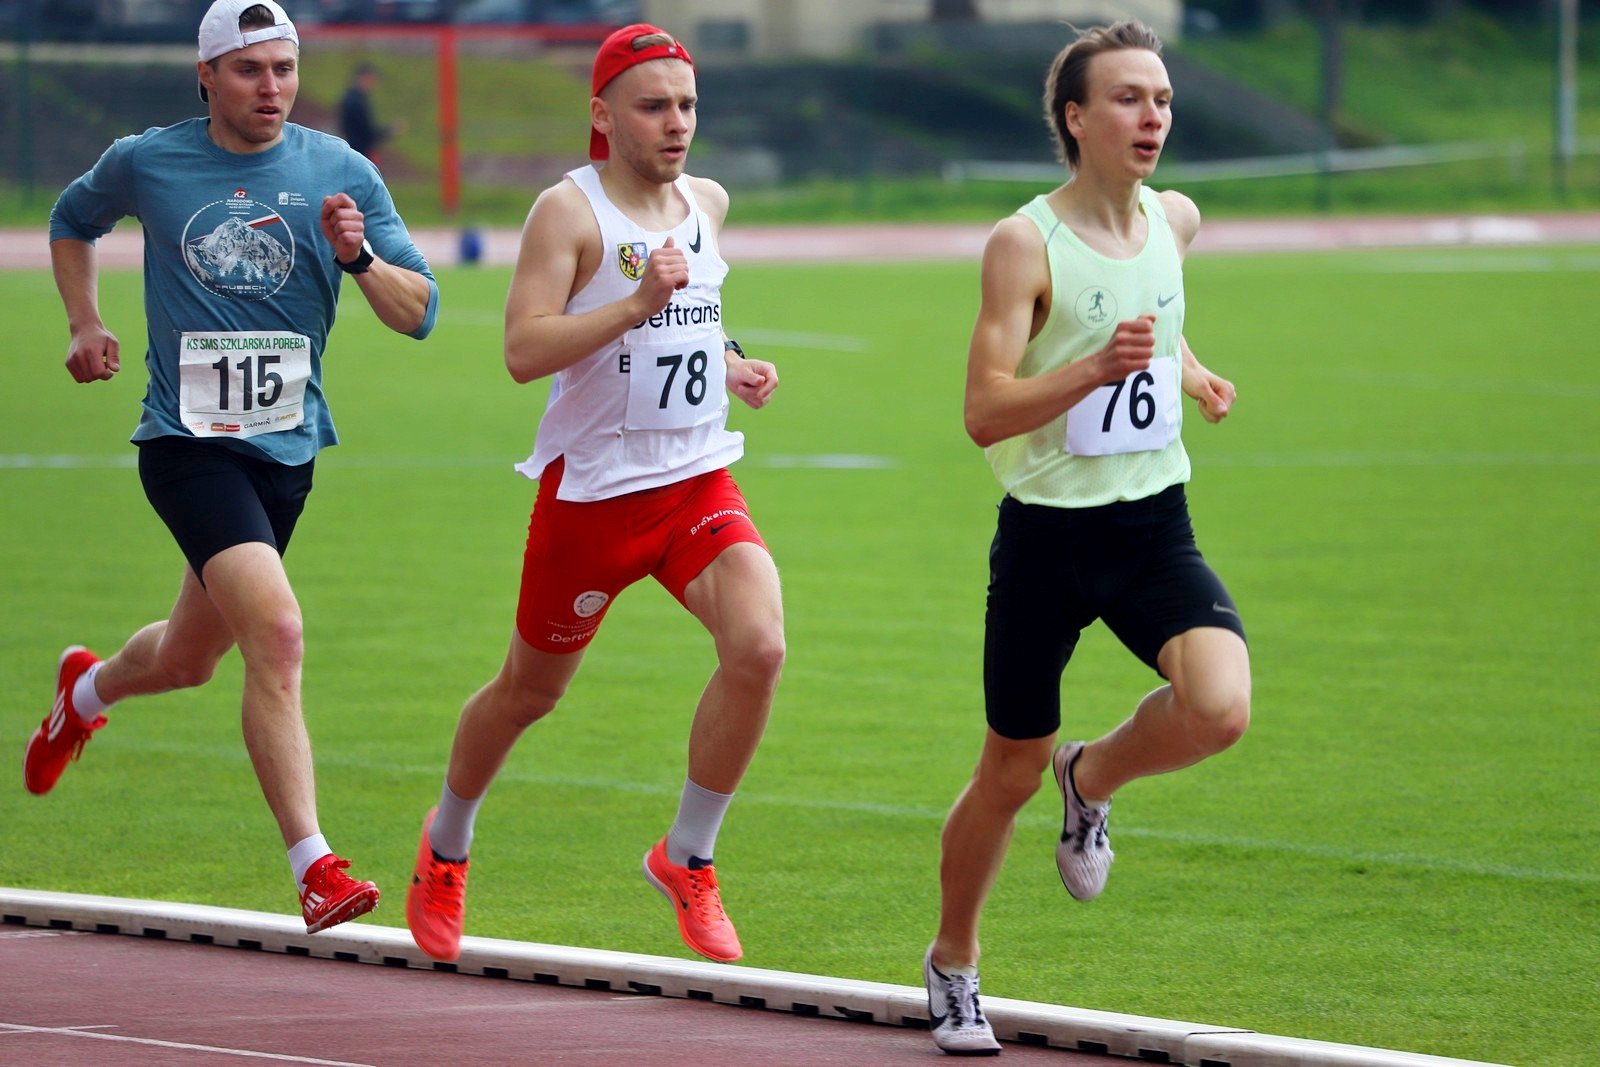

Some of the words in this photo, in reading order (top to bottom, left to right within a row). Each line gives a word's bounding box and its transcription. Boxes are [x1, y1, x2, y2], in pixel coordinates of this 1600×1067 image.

[187, 339, 199, 350] KS
[200, 338, 219, 350] SMS
[220, 338, 271, 350] SZKLARSKA
[272, 337, 306, 351] PORĘBA
[212, 355, 284, 411] 115
[656, 350, 708, 409] 78
[1101, 371, 1155, 433] 76
[244, 417, 271, 428] GARMIN
